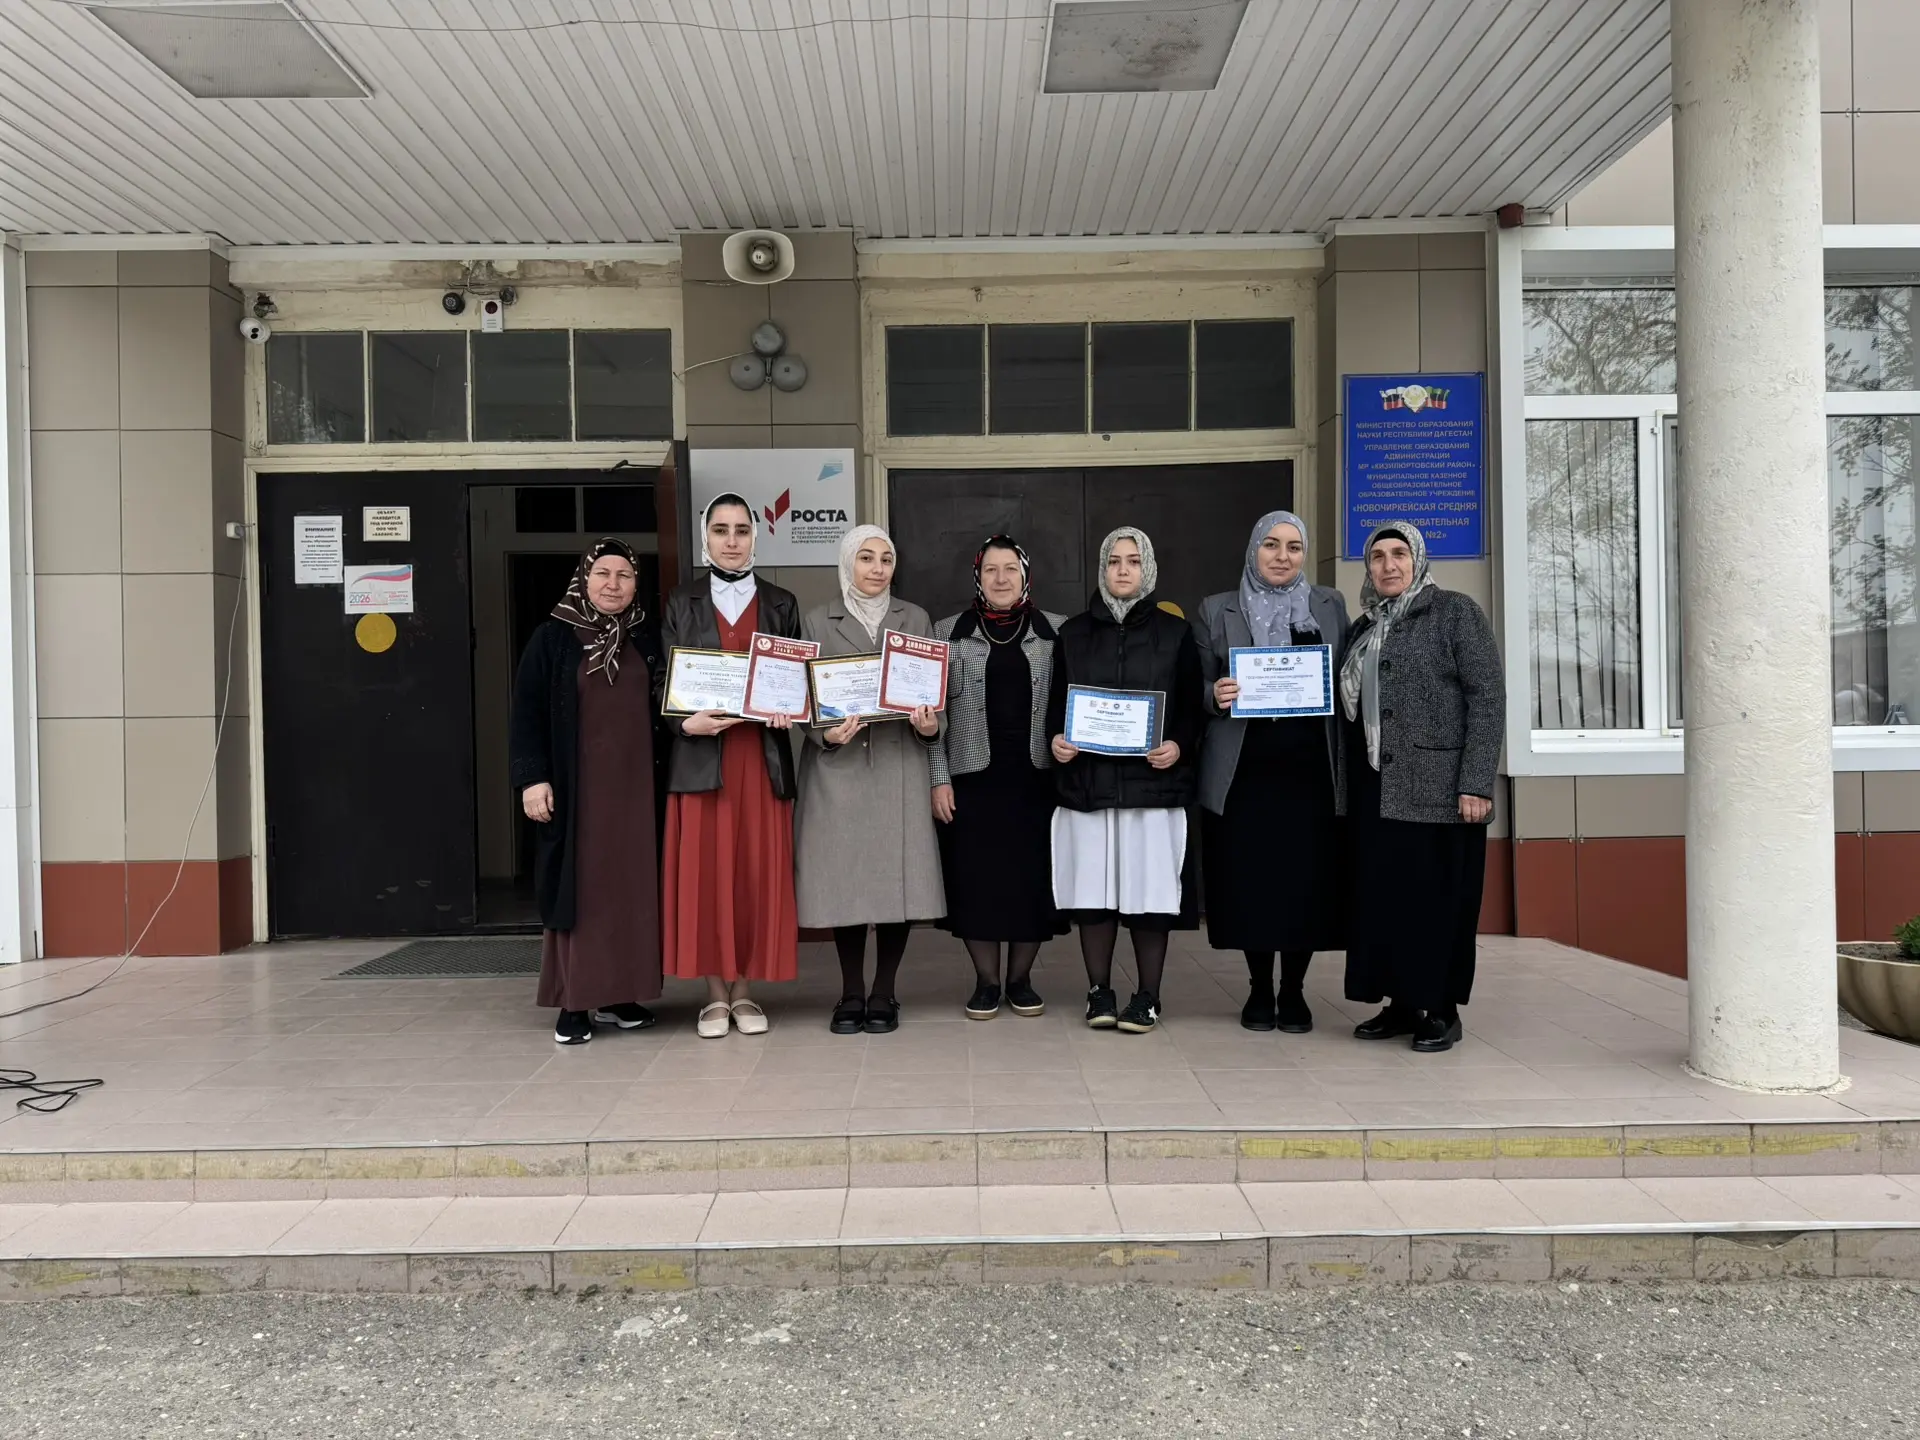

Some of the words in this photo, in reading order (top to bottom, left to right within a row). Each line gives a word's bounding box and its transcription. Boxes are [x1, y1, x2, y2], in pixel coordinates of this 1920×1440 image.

[1353, 502, 1436, 512] «НОВОЧИРКЕЙСКАЯ
[1438, 502, 1478, 511] СРЕДНЯЯ
[791, 510, 848, 522] РОСТА
[1426, 530, 1446, 539] №2»
[906, 640, 932, 652] ДИПЛОМ
